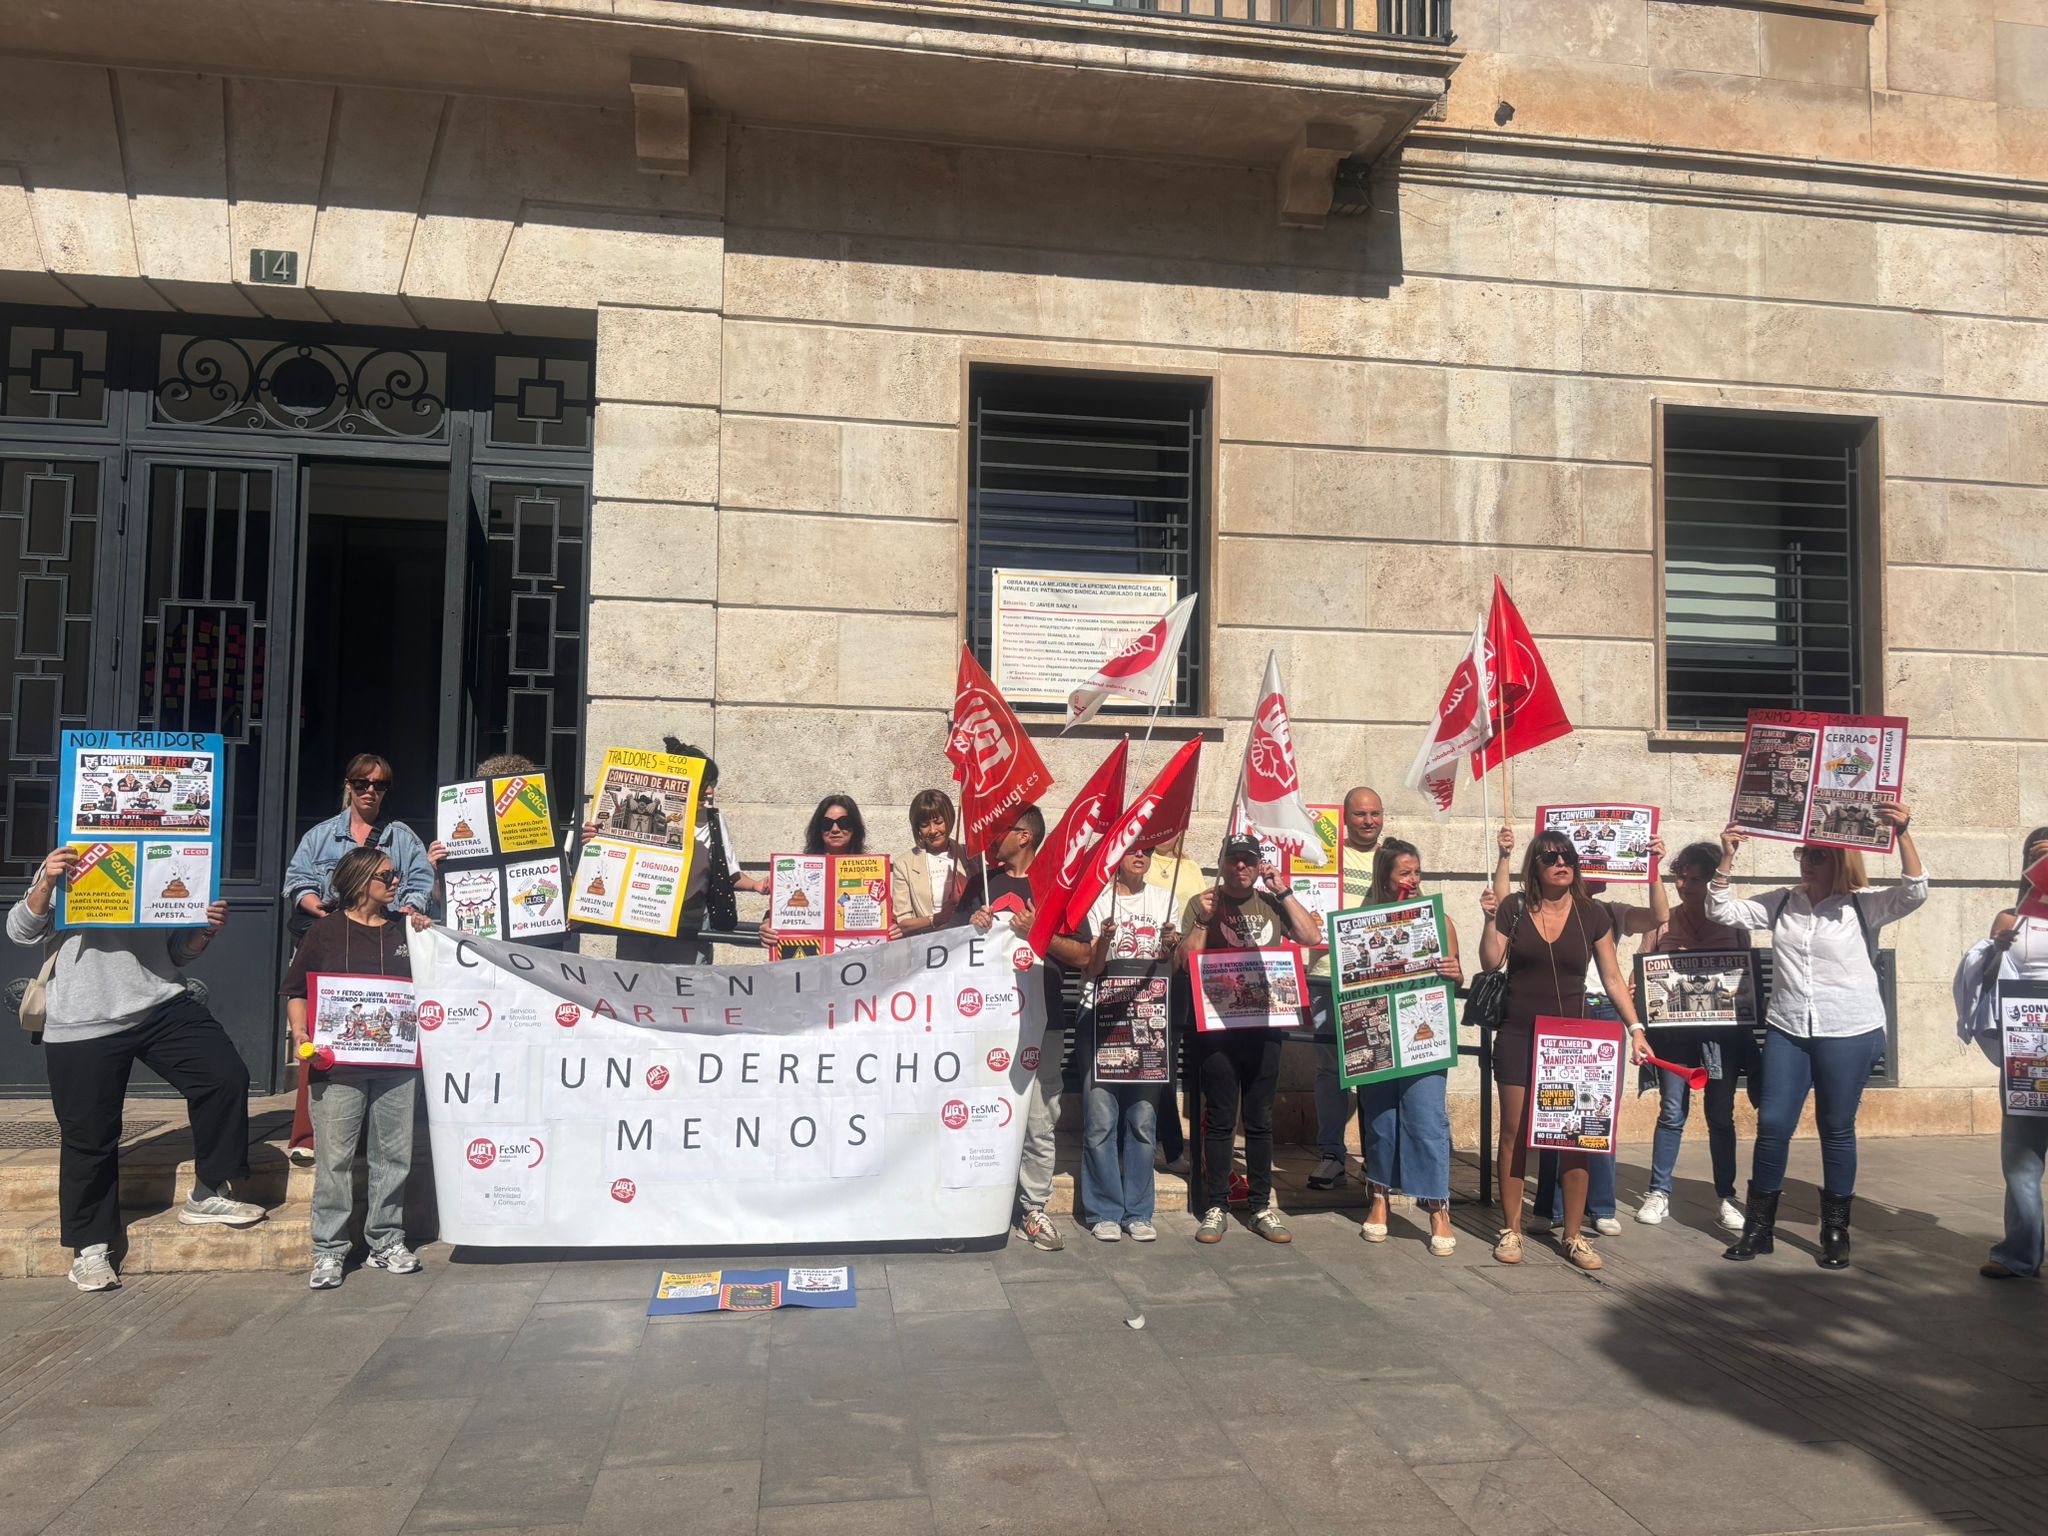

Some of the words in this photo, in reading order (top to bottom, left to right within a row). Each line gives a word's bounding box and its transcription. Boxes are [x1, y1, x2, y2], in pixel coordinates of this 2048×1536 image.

[260, 250, 290, 281] 14
[1797, 712, 1820, 726] 23
[116, 732, 205, 750] TRAIDOR
[1884, 730, 1894, 763] HUELGA
[100, 756, 145, 766] CONVENIO
[608, 750, 657, 769] TRAIDORES
[608, 770, 648, 786] CONVENIO
[650, 777, 662, 788] DE
[664, 779, 688, 792] ARTE
[495, 779, 524, 814] CCOO
[1815, 786, 1856, 800] CONVENIO
[1858, 792, 1870, 801] DE
[1871, 793, 1894, 802] ARTE
[524, 786, 548, 816] Fetico
[971, 771, 1040, 834] www.ugt.es
[1561, 811, 1595, 820] CONVENIO
[446, 839, 481, 847] NUESTRAS
[146, 846, 173, 855] Fetico
[447, 847, 489, 857] ONDICIONES
[106, 853, 134, 888] Fetico
[641, 861, 679, 873] DIGNIDAD
[638, 872, 674, 883] PRECARIEDAD
[525, 896, 545, 904] CLOSE
[602, 900, 614, 908] QUE
[632, 909, 660, 917] INFELICIDAD
[1227, 914, 1264, 924] MOTOR
[530, 919, 562, 928] HUELGA
[1352, 913, 1387, 929] CONVENIO
[1015, 949, 1034, 960] UGT
[456, 939, 867, 996] CONVENIO
[927, 938, 984, 969] DE
[1647, 958, 1699, 971] CONVENIO
[1702, 957, 1716, 967] DE
[1720, 957, 1745, 967] ARTE
[959, 991, 981, 1004] UGT
[985, 993, 1013, 1004] FeSMC
[1337, 986, 1379, 1002] HUELGA
[419, 1004, 442, 1018] UGT
[447, 1007, 479, 1017] FeSMC
[557, 1003, 579, 1016] UGT
[592, 998, 742, 1025] ARTE
[1434, 1040, 1447, 1048] QUE
[1558, 1040, 1588, 1048] ALMERÍA
[989, 1050, 1009, 1062] UGT
[1022, 1049, 1040, 1061] UGT
[1544, 1054, 1597, 1065] MANIFESTACIÓN
[444, 1072, 501, 1104] NI
[561, 1058, 631, 1088] UN
[699, 1051, 960, 1084] DERECHO
[1541, 1090, 1574, 1098] CONVENIO
[944, 1103, 966, 1116] UGT
[971, 1104, 999, 1114] FeSMC
[618, 1114, 867, 1150] MENOS
[469, 1142, 494, 1155] UGT
[499, 1145, 531, 1154] FeSMC
[613, 1179, 634, 1192] UGT
